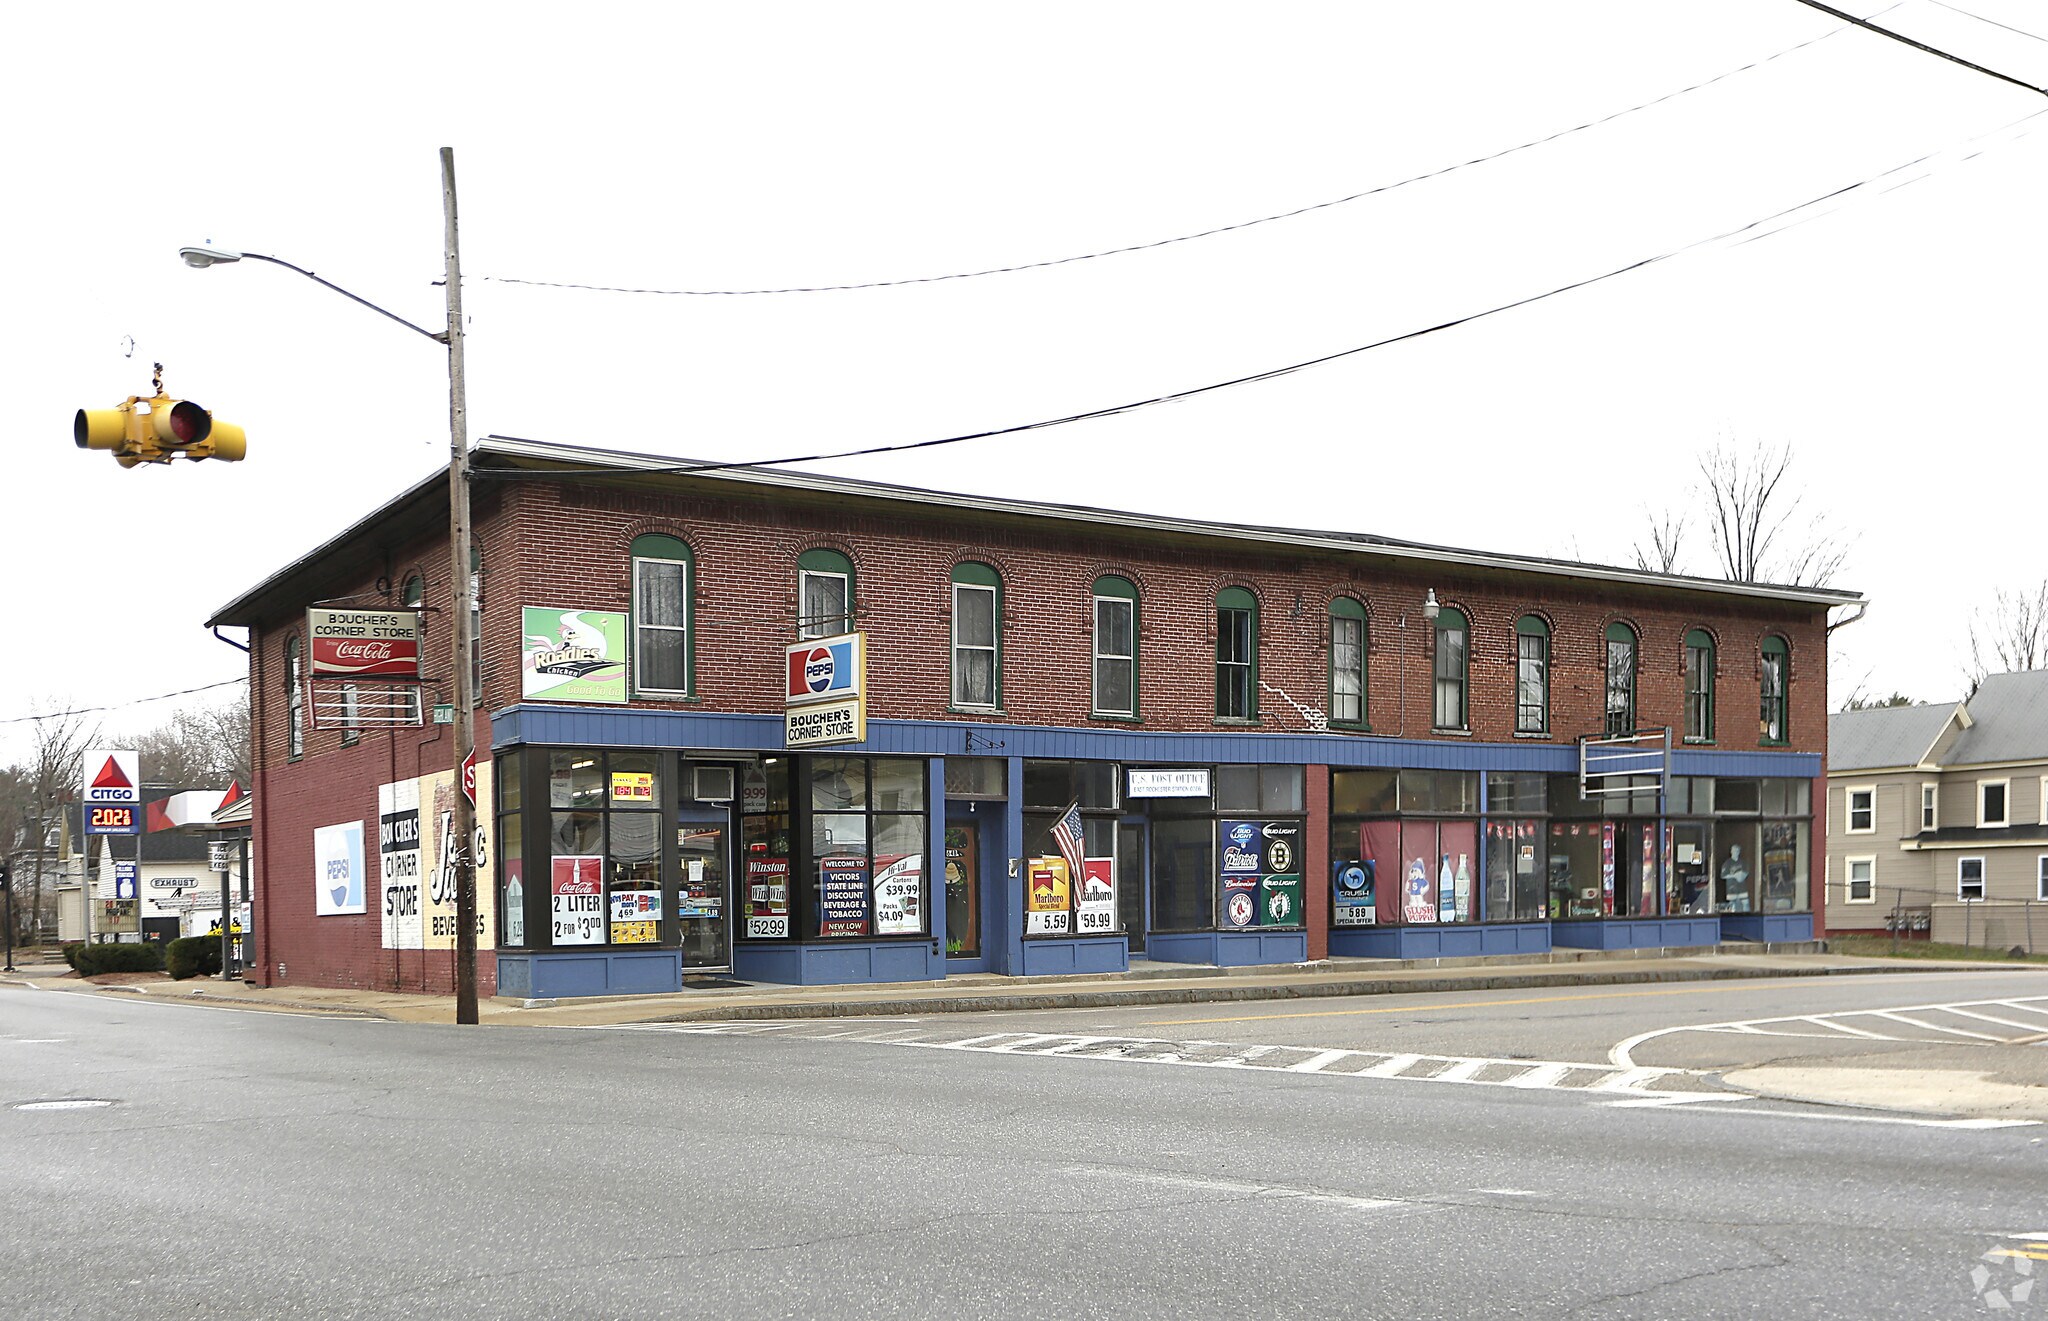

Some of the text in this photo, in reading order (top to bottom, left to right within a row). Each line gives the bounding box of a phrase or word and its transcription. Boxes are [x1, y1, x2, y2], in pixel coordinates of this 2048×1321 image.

[329, 614, 398, 626] BOUCHER'S
[315, 625, 414, 637] CORNER STORE
[336, 640, 393, 659] Coca-Cola
[534, 646, 600, 669] Roadies
[546, 667, 578, 677] Chicken
[806, 662, 833, 677] PEPSI
[566, 685, 621, 696] Good To Go
[790, 710, 850, 726] BOUCHER'S
[788, 721, 854, 740] CORNER STORE
[1151, 774, 1173, 784] POST
[1175, 773, 1206, 784] OFFICE
[91, 789, 133, 799] CITGO
[616, 786, 631, 796] 184
[1276, 848, 1285, 863] B
[327, 858, 350, 880] PEPSI
[749, 861, 786, 873] Winston
[825, 860, 854, 868] WELCOME
[887, 861, 908, 876] Hi-Val
[829, 872, 860, 881] VICTORS
[154, 879, 195, 887] EXHAUST
[558, 882, 594, 894] Coca-Cola
[826, 882, 864, 890] STATE LINE
[886, 884, 918, 896] $39.99
[386, 885, 418, 916] STORE
[554, 896, 600, 912] 2 LITER
[621, 894, 635, 902] PAY
[1034, 893, 1064, 903] Marlboro
[823, 901, 860, 909] BEVERAGE
[1405, 906, 1434, 914] SLUSH
[828, 910, 863, 919] TOBACCO
[878, 910, 904, 922] $4.09
[1081, 912, 1110, 928] $59.99
[1408, 913, 1436, 921] PUPPIE
[432, 914, 485, 936] BEVEES
[828, 922, 863, 930] NEW LOW
[1044, 914, 1067, 930] 5.59
[554, 921, 562, 937] 2
[563, 924, 576, 935] FOR
